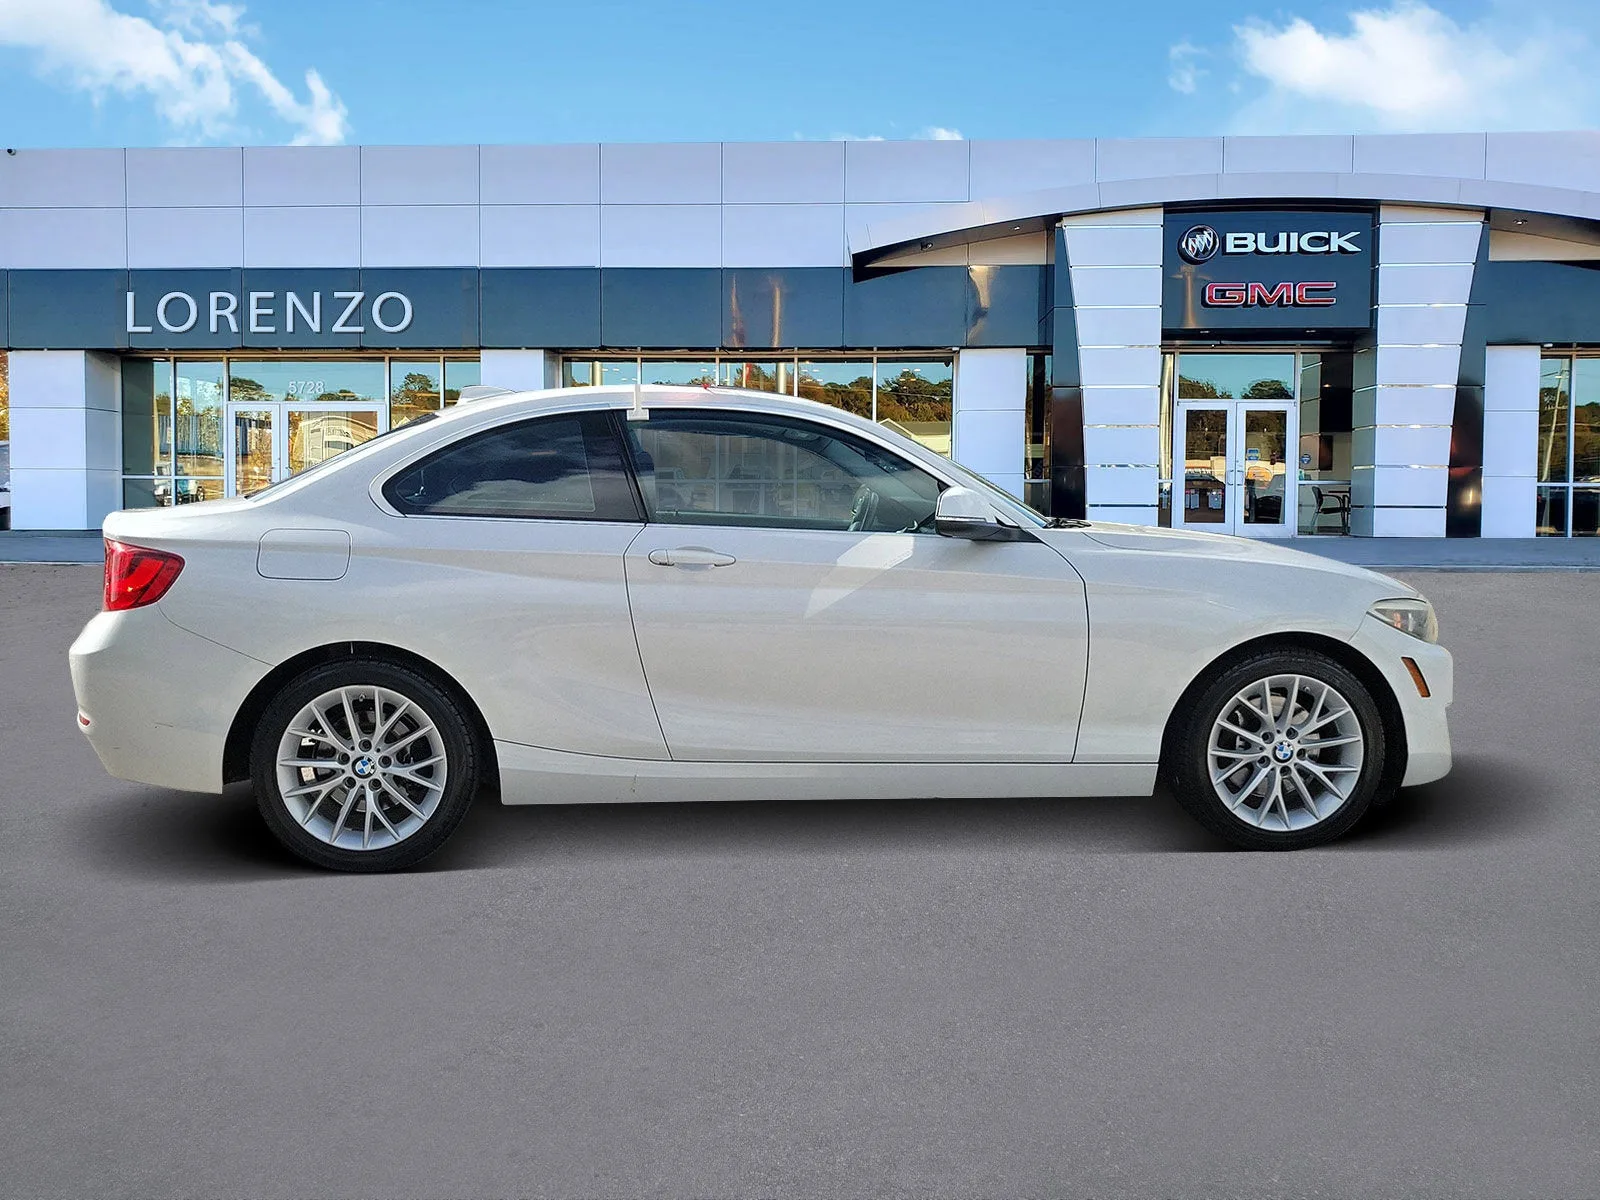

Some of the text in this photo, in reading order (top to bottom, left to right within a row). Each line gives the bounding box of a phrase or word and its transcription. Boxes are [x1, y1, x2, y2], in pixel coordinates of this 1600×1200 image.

[1225, 231, 1362, 253] BUICK
[1205, 282, 1337, 305] GMC
[126, 291, 413, 333] LORENZO
[288, 381, 325, 394] 5728
